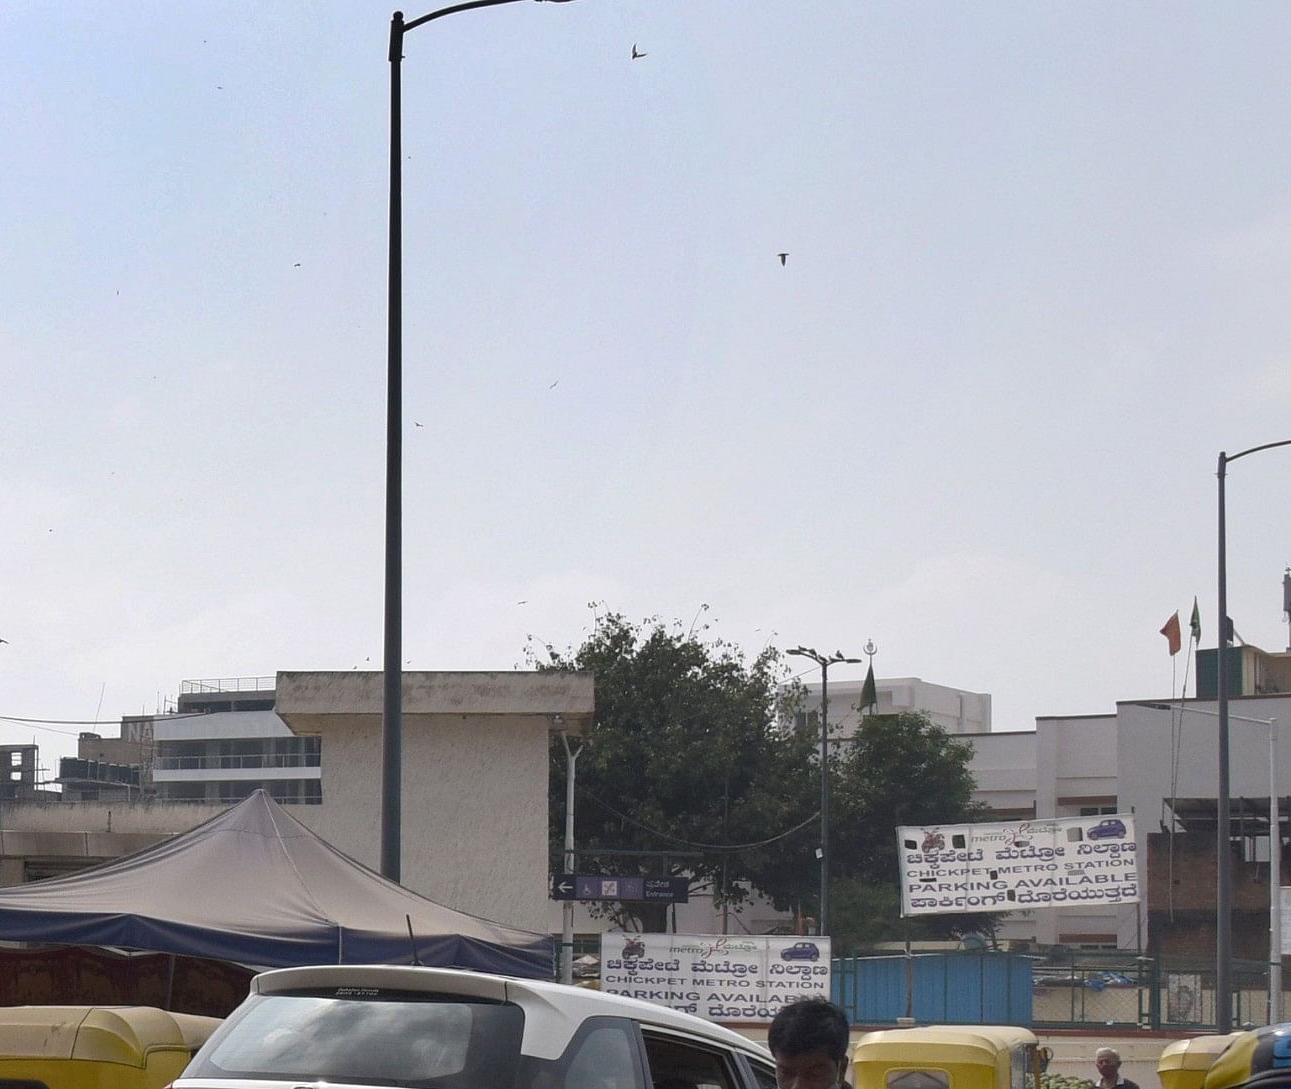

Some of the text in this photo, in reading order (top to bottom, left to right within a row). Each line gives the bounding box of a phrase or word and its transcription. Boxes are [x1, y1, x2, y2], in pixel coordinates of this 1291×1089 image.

[906, 841, 1137, 869] ಚಿಕ್ಕಪೇಟೆ ಮೆಟ್ರೋ ನಿಲ್ದಾಣ
[907, 859, 1134, 878] CHICKPET METRO STATION
[909, 872, 1137, 893] PARKING AVAILABLE
[1018, 883, 1137, 904] ದೊರೆಯುತ್ತದೆ
[606, 958, 828, 981] ಚಿಕ್ಕಪೇಟೆ ಮೆಟ್ರೋ ನಿಲ್ದಾಣ
[605, 975, 825, 989] CHICKPET METRO STATION
[707, 993, 826, 1004] AVAILAB
